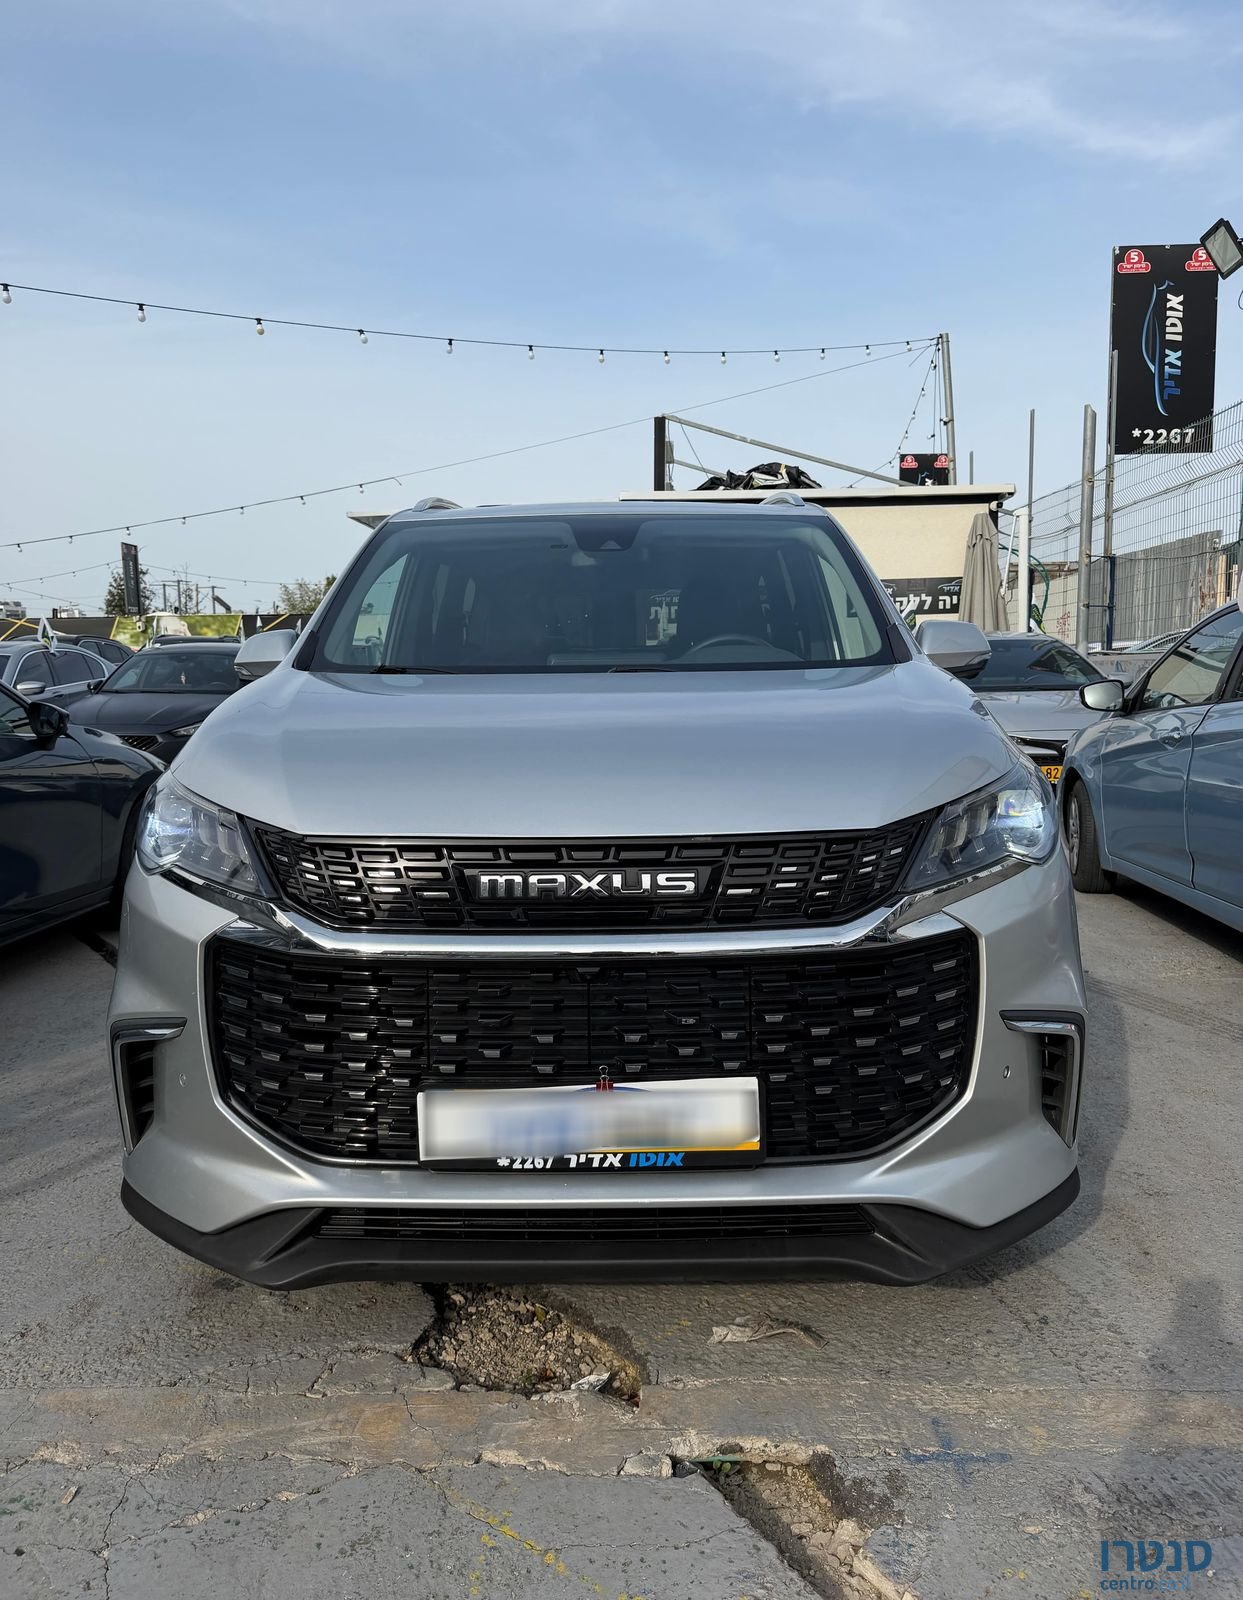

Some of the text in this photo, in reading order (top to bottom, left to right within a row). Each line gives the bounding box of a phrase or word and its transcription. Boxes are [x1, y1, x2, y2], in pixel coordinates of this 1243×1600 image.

[1131, 252, 1139, 262] 5
[1198, 250, 1206, 260] 5
[1164, 293, 1183, 399] אוטו אדיר
[938, 595, 958, 610] יה
[480, 872, 697, 897] MAXUS
[563, 1153, 623, 1168] אדיר
[629, 1152, 685, 1167] אוטו
